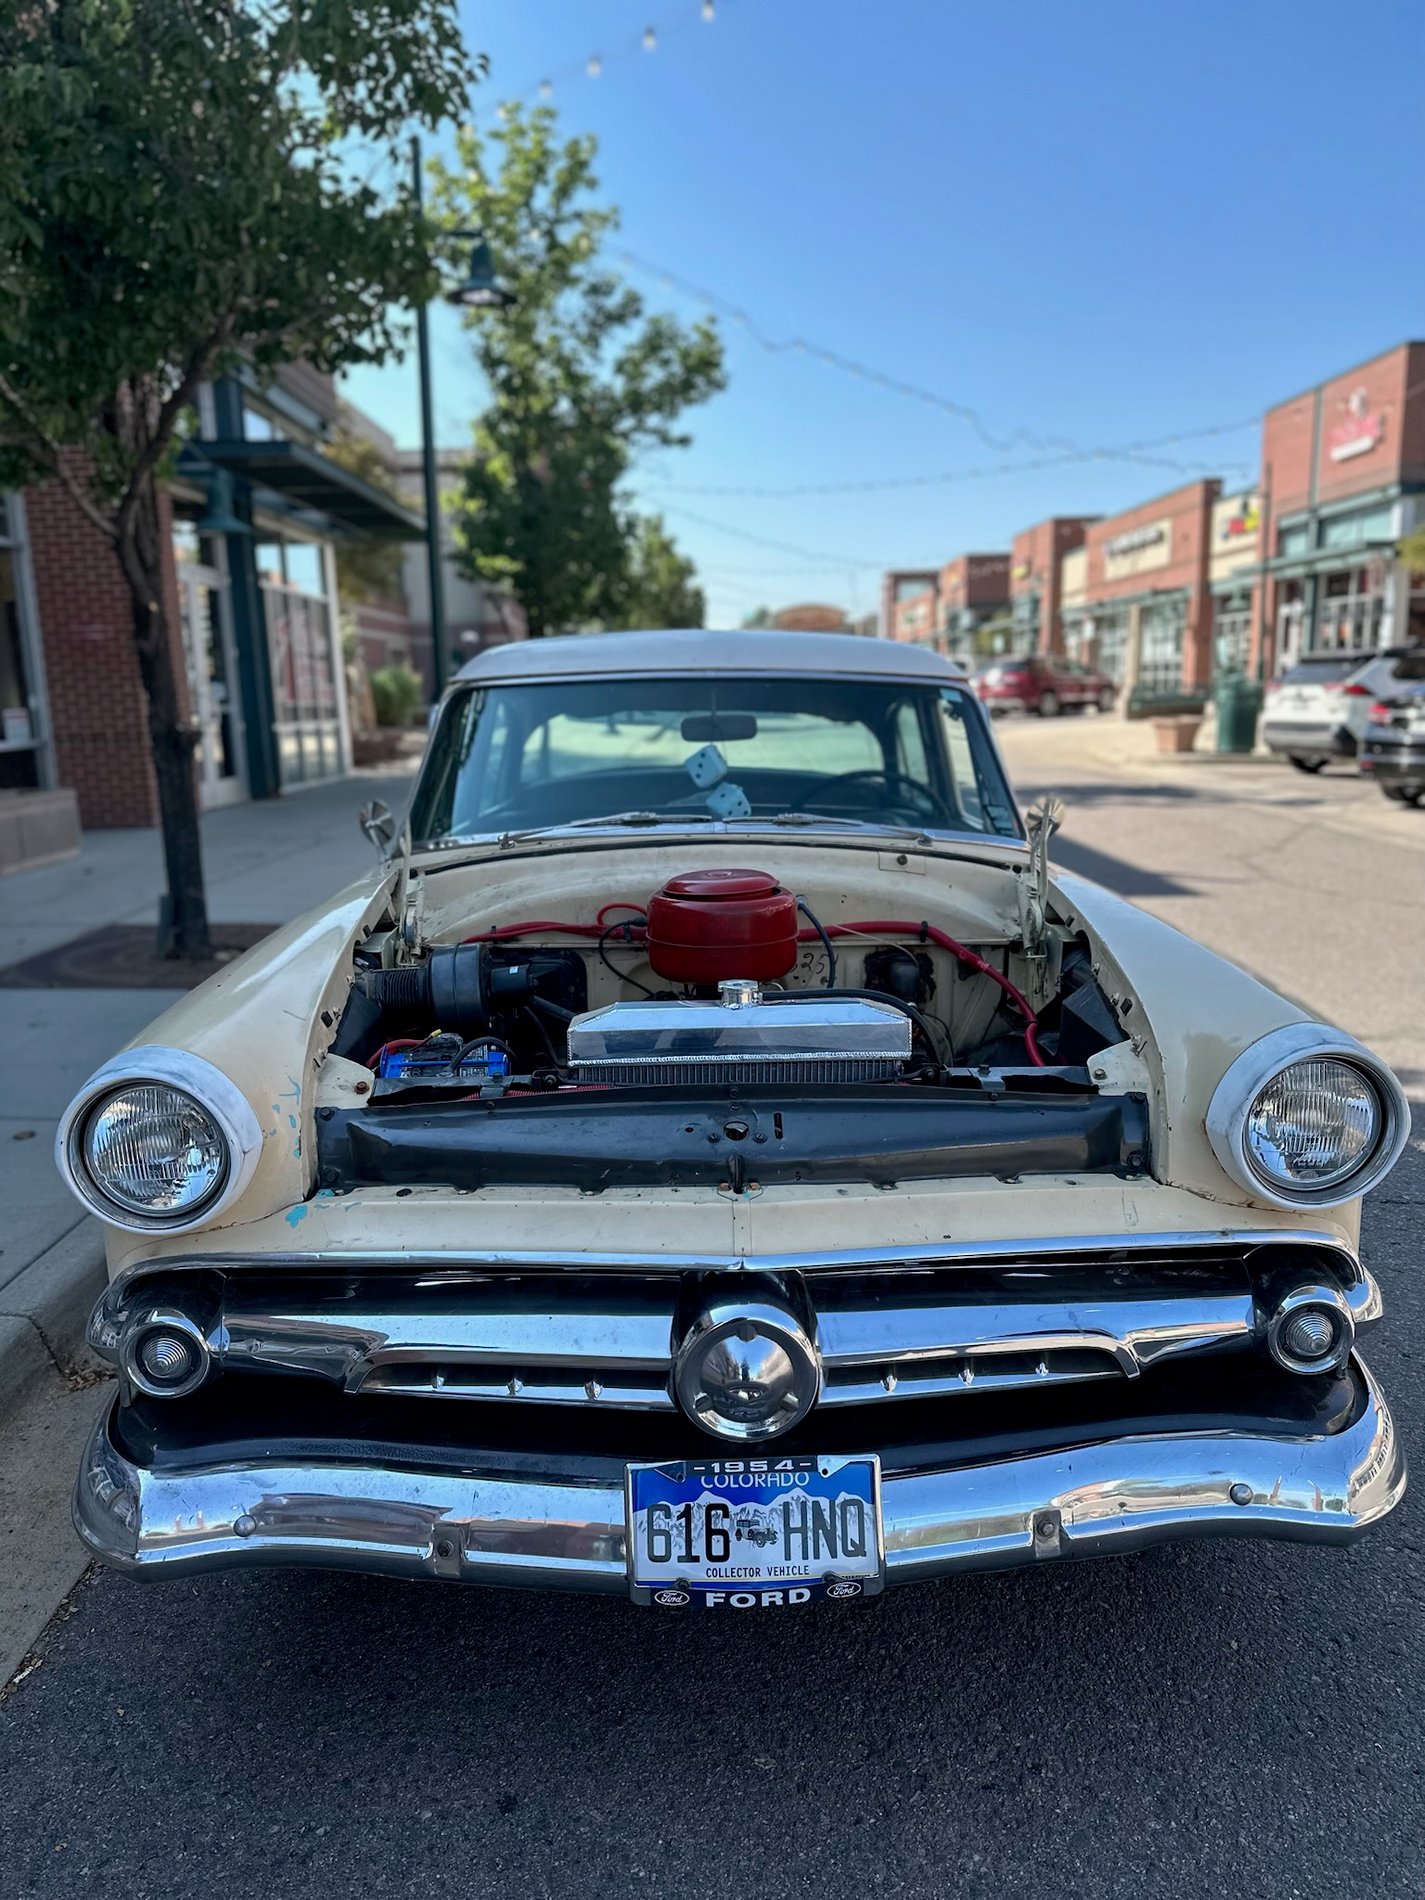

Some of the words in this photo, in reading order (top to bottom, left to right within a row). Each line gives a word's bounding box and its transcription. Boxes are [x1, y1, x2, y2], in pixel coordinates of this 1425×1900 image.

[700, 1471, 810, 1488] COLORADO
[647, 1503, 730, 1562] 616
[783, 1499, 867, 1561] HNQ
[705, 1567, 762, 1578] COLLECTOR
[767, 1565, 810, 1577] VEHICLE
[660, 1591, 684, 1604] Ford
[705, 1587, 811, 1608] FORD
[832, 1584, 855, 1597] Ford
